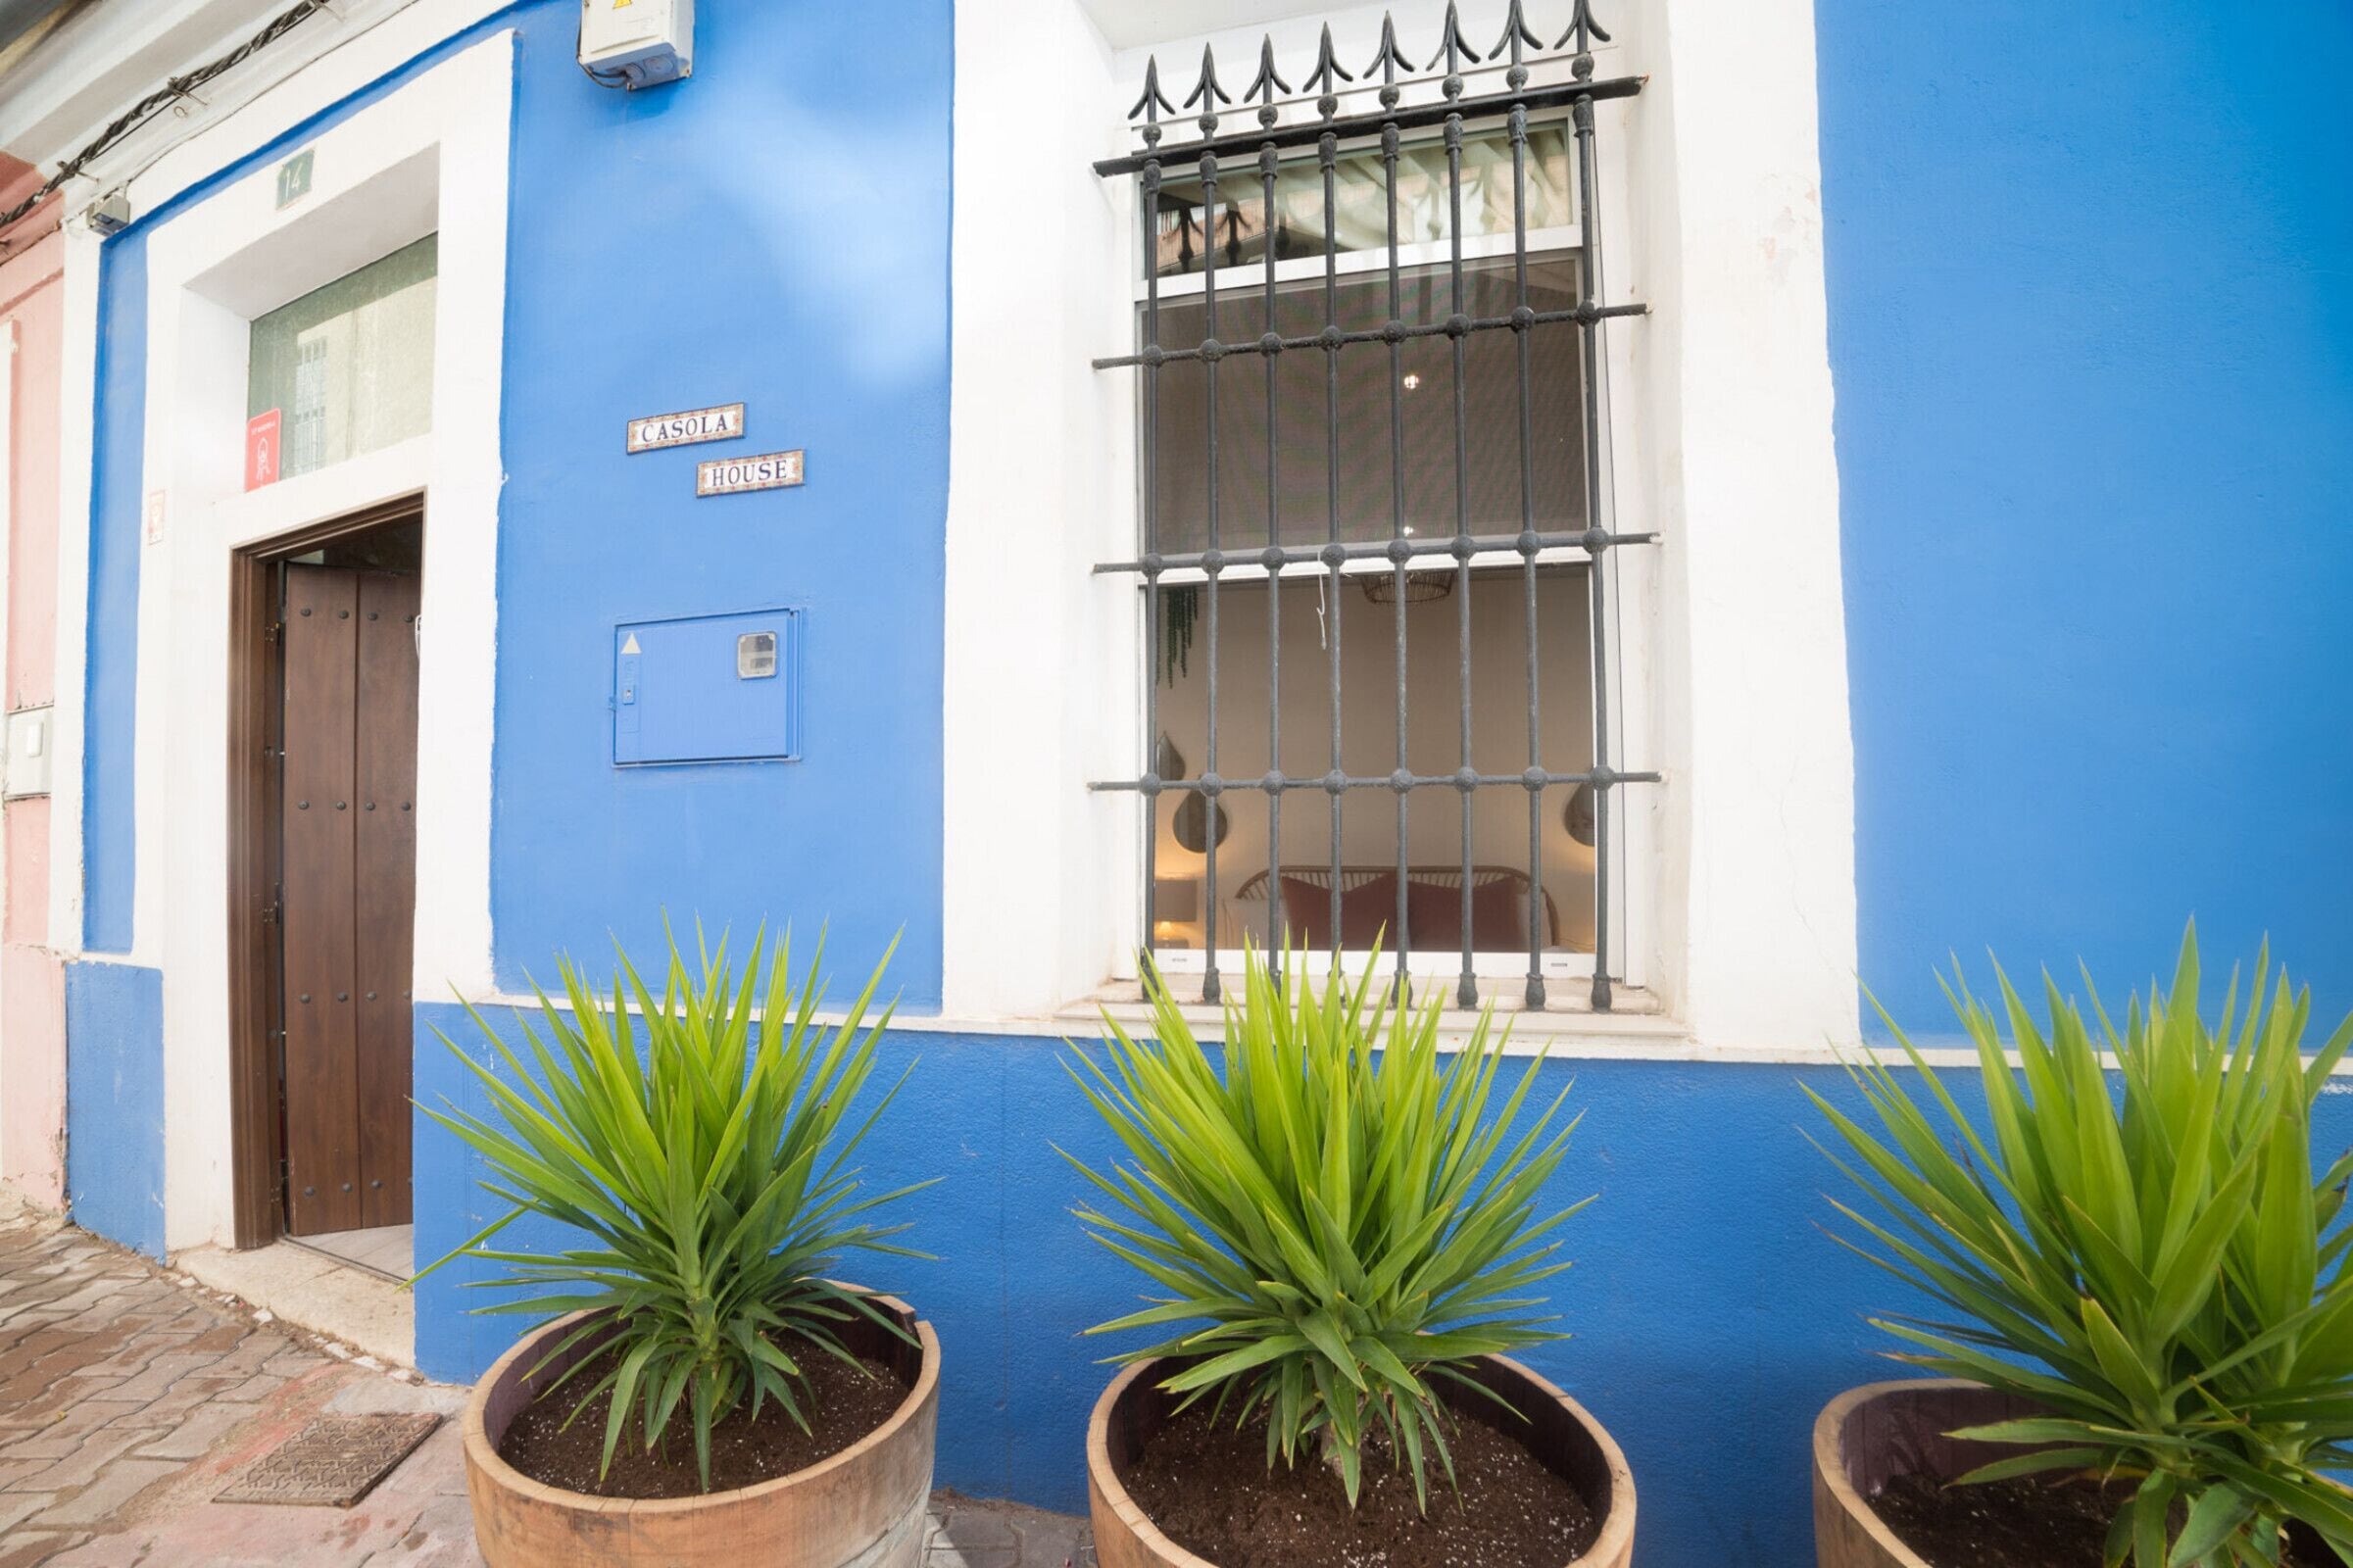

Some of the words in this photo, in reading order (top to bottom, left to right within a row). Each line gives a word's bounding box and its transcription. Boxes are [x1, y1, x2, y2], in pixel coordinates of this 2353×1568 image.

[285, 162, 302, 199] 14
[642, 414, 728, 442] CASOLA
[711, 460, 787, 486] HOUSE
